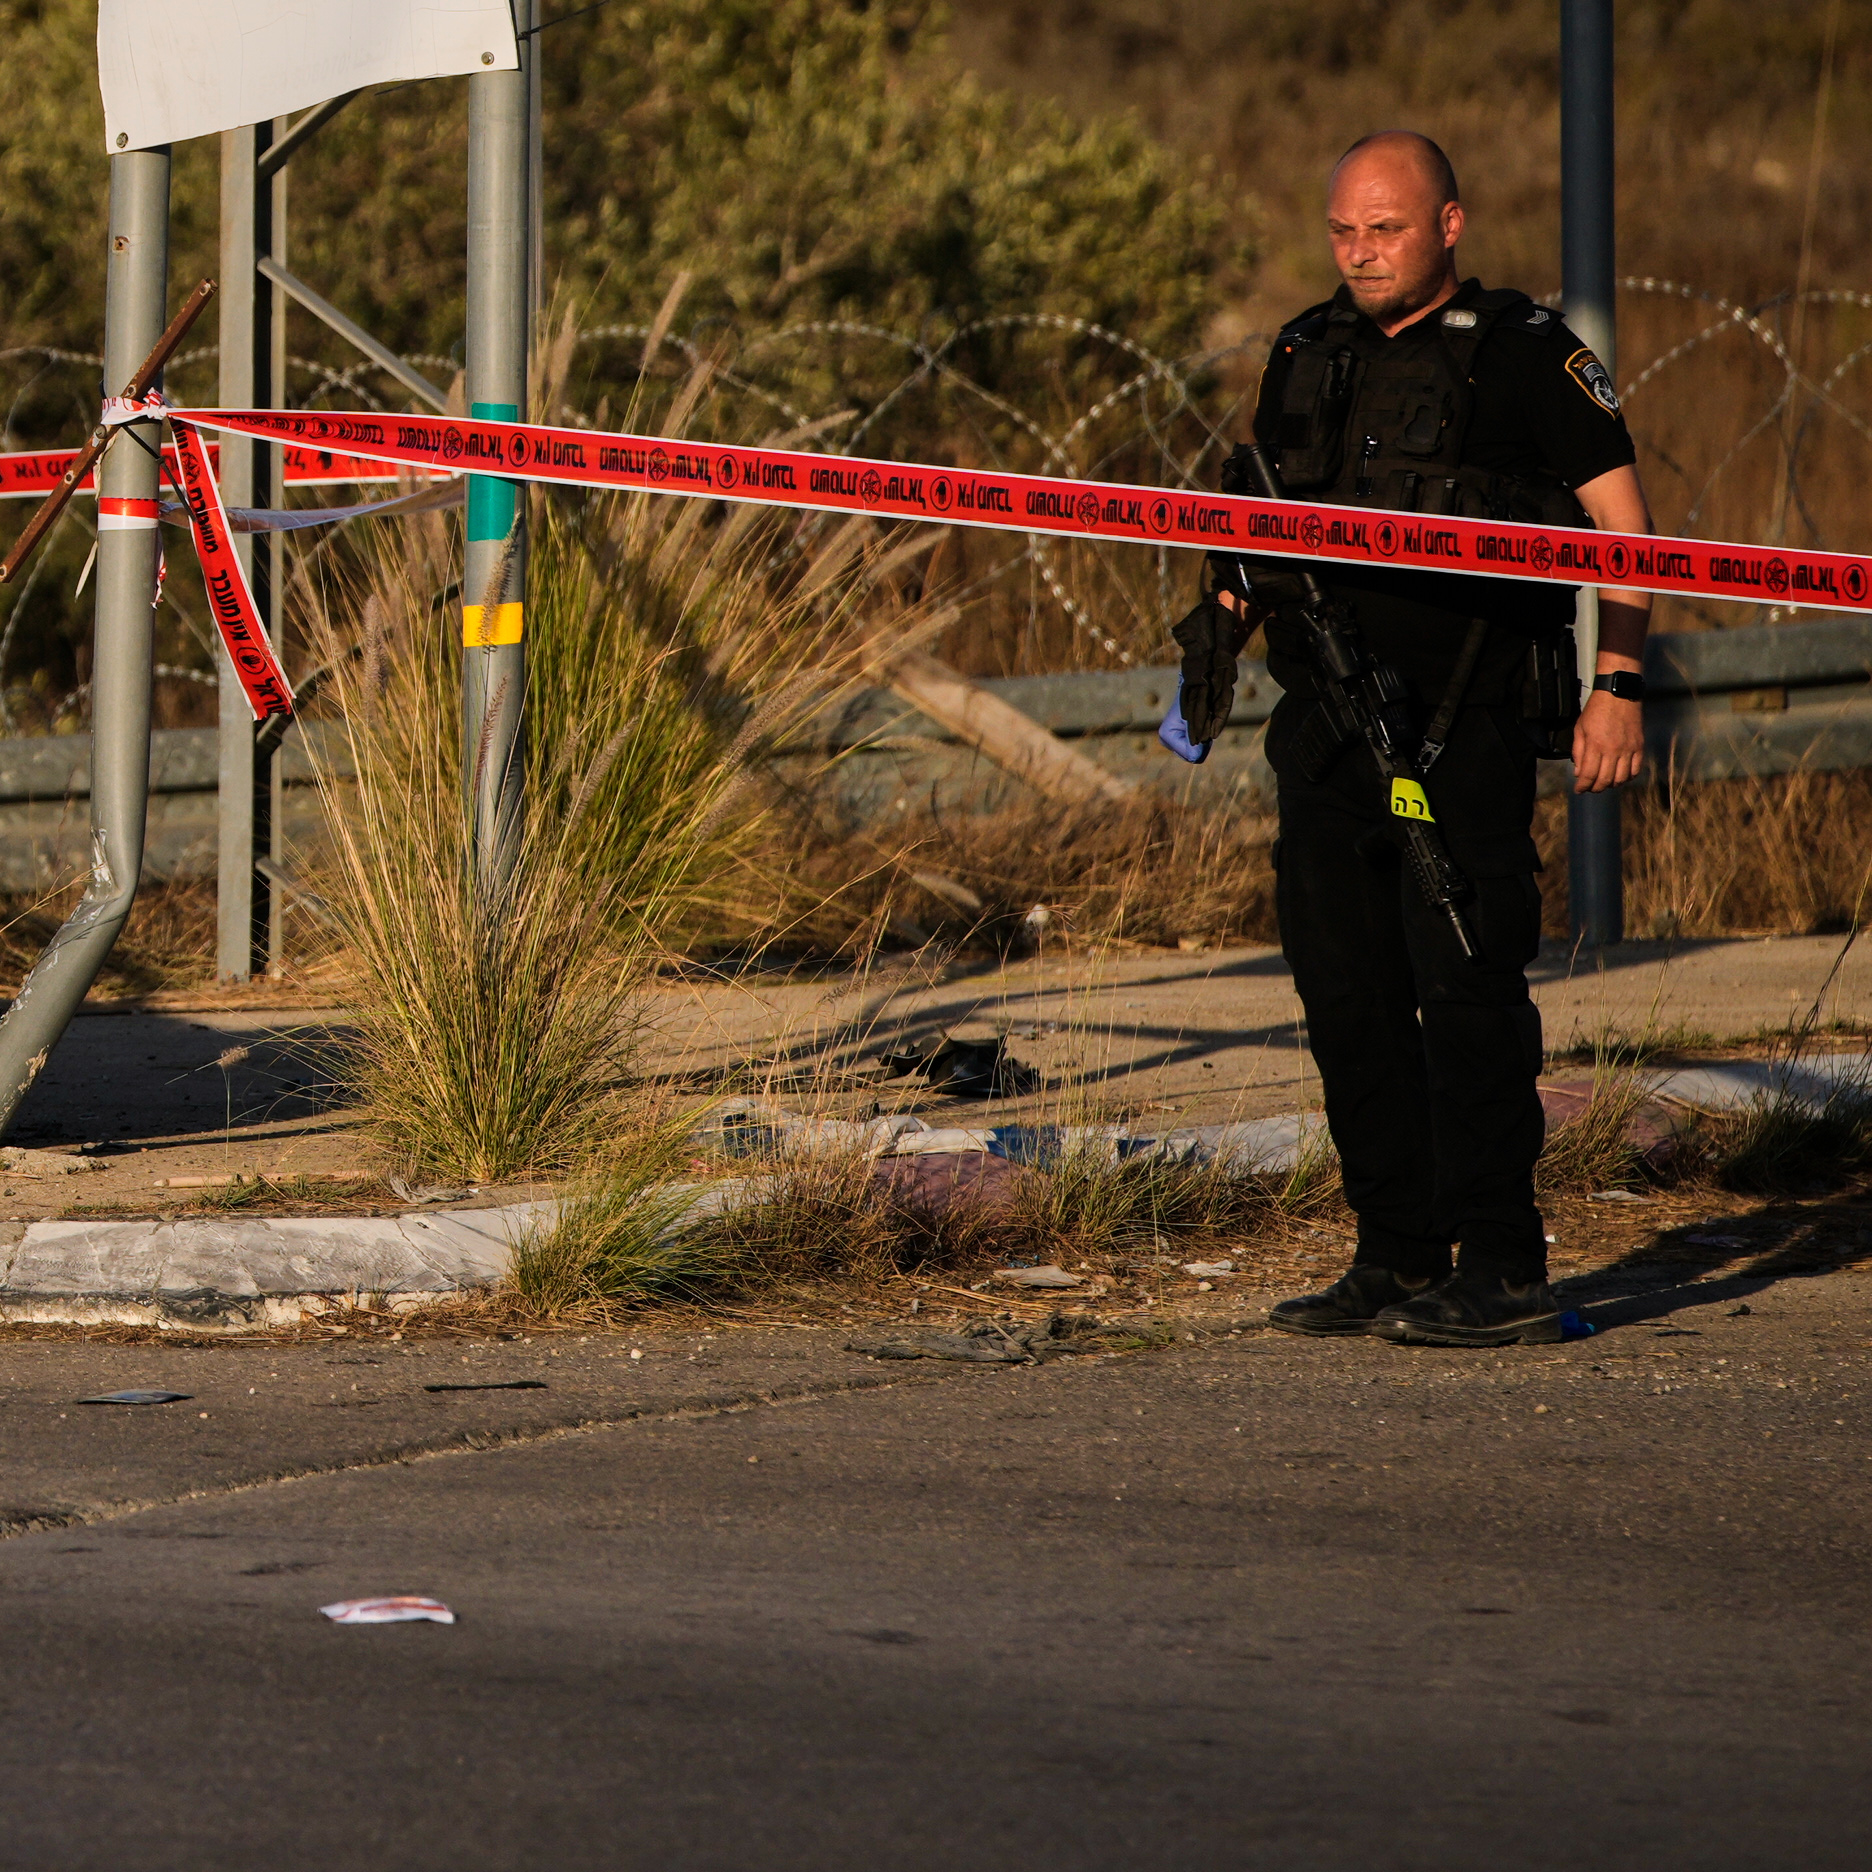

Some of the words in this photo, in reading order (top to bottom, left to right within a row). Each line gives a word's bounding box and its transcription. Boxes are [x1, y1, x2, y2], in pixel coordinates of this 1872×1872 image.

[397, 427, 440, 453] משטרת
[464, 433, 504, 465] ישראל
[533, 436, 550, 465] אין
[553, 442, 587, 469] מעבר
[14, 458, 43, 479] אין
[599, 447, 645, 474] משטרת
[671, 454, 712, 487] ישראל
[743, 459, 761, 486] אין
[762, 463, 797, 490] מעבר
[810, 469, 858, 497] משטרת
[883, 476, 927, 509] ישראל
[957, 480, 976, 508] אין
[978, 485, 1013, 513] מעבר
[1026, 491, 1074, 519] משטרת
[1101, 499, 1146, 532] ישראל
[1177, 502, 1197, 531] אין
[1198, 508, 1235, 536] מעבר
[1248, 513, 1299, 541] משטרת
[1325, 520, 1371, 555] ישראל
[1403, 524, 1422, 554] אין
[1424, 530, 1463, 558] מעבר
[1476, 535, 1528, 564] משטרת
[1555, 542, 1602, 578] ישראל
[1635, 545, 1654, 576] אין
[1656, 551, 1696, 580] מעבר
[209, 569, 242, 622] מעבר
[1709, 557, 1763, 586] משטרת
[1791, 564, 1840, 600] ישראל
[228, 617, 252, 642] אין
[1395, 796, 1424, 816] רה
